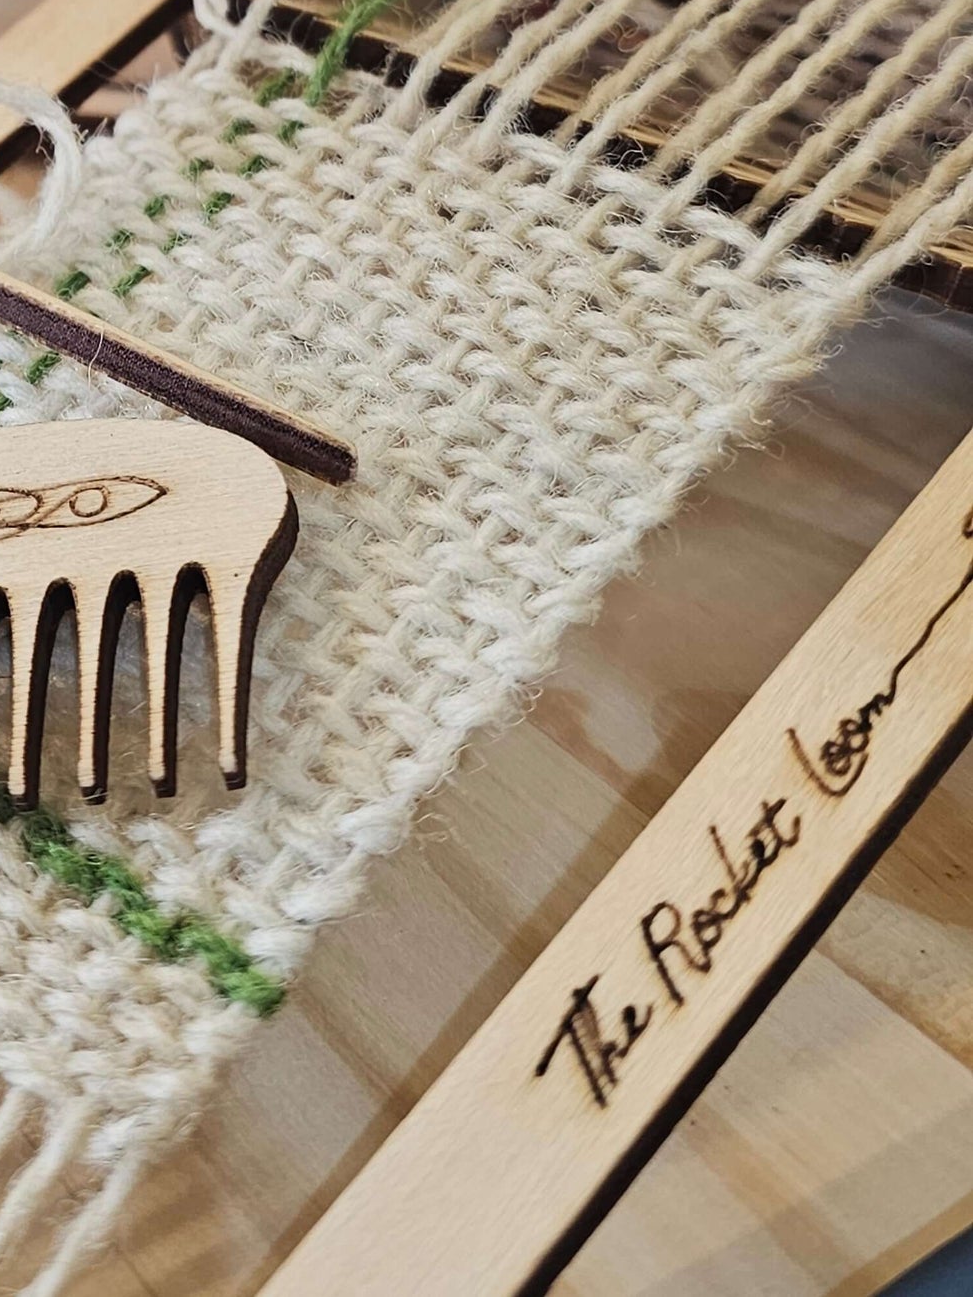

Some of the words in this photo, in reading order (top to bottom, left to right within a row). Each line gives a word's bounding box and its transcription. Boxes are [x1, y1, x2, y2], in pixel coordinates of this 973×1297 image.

[534, 974, 653, 1108] The
[641, 798, 801, 1008] Rocket
[786, 692, 895, 797] Loom
